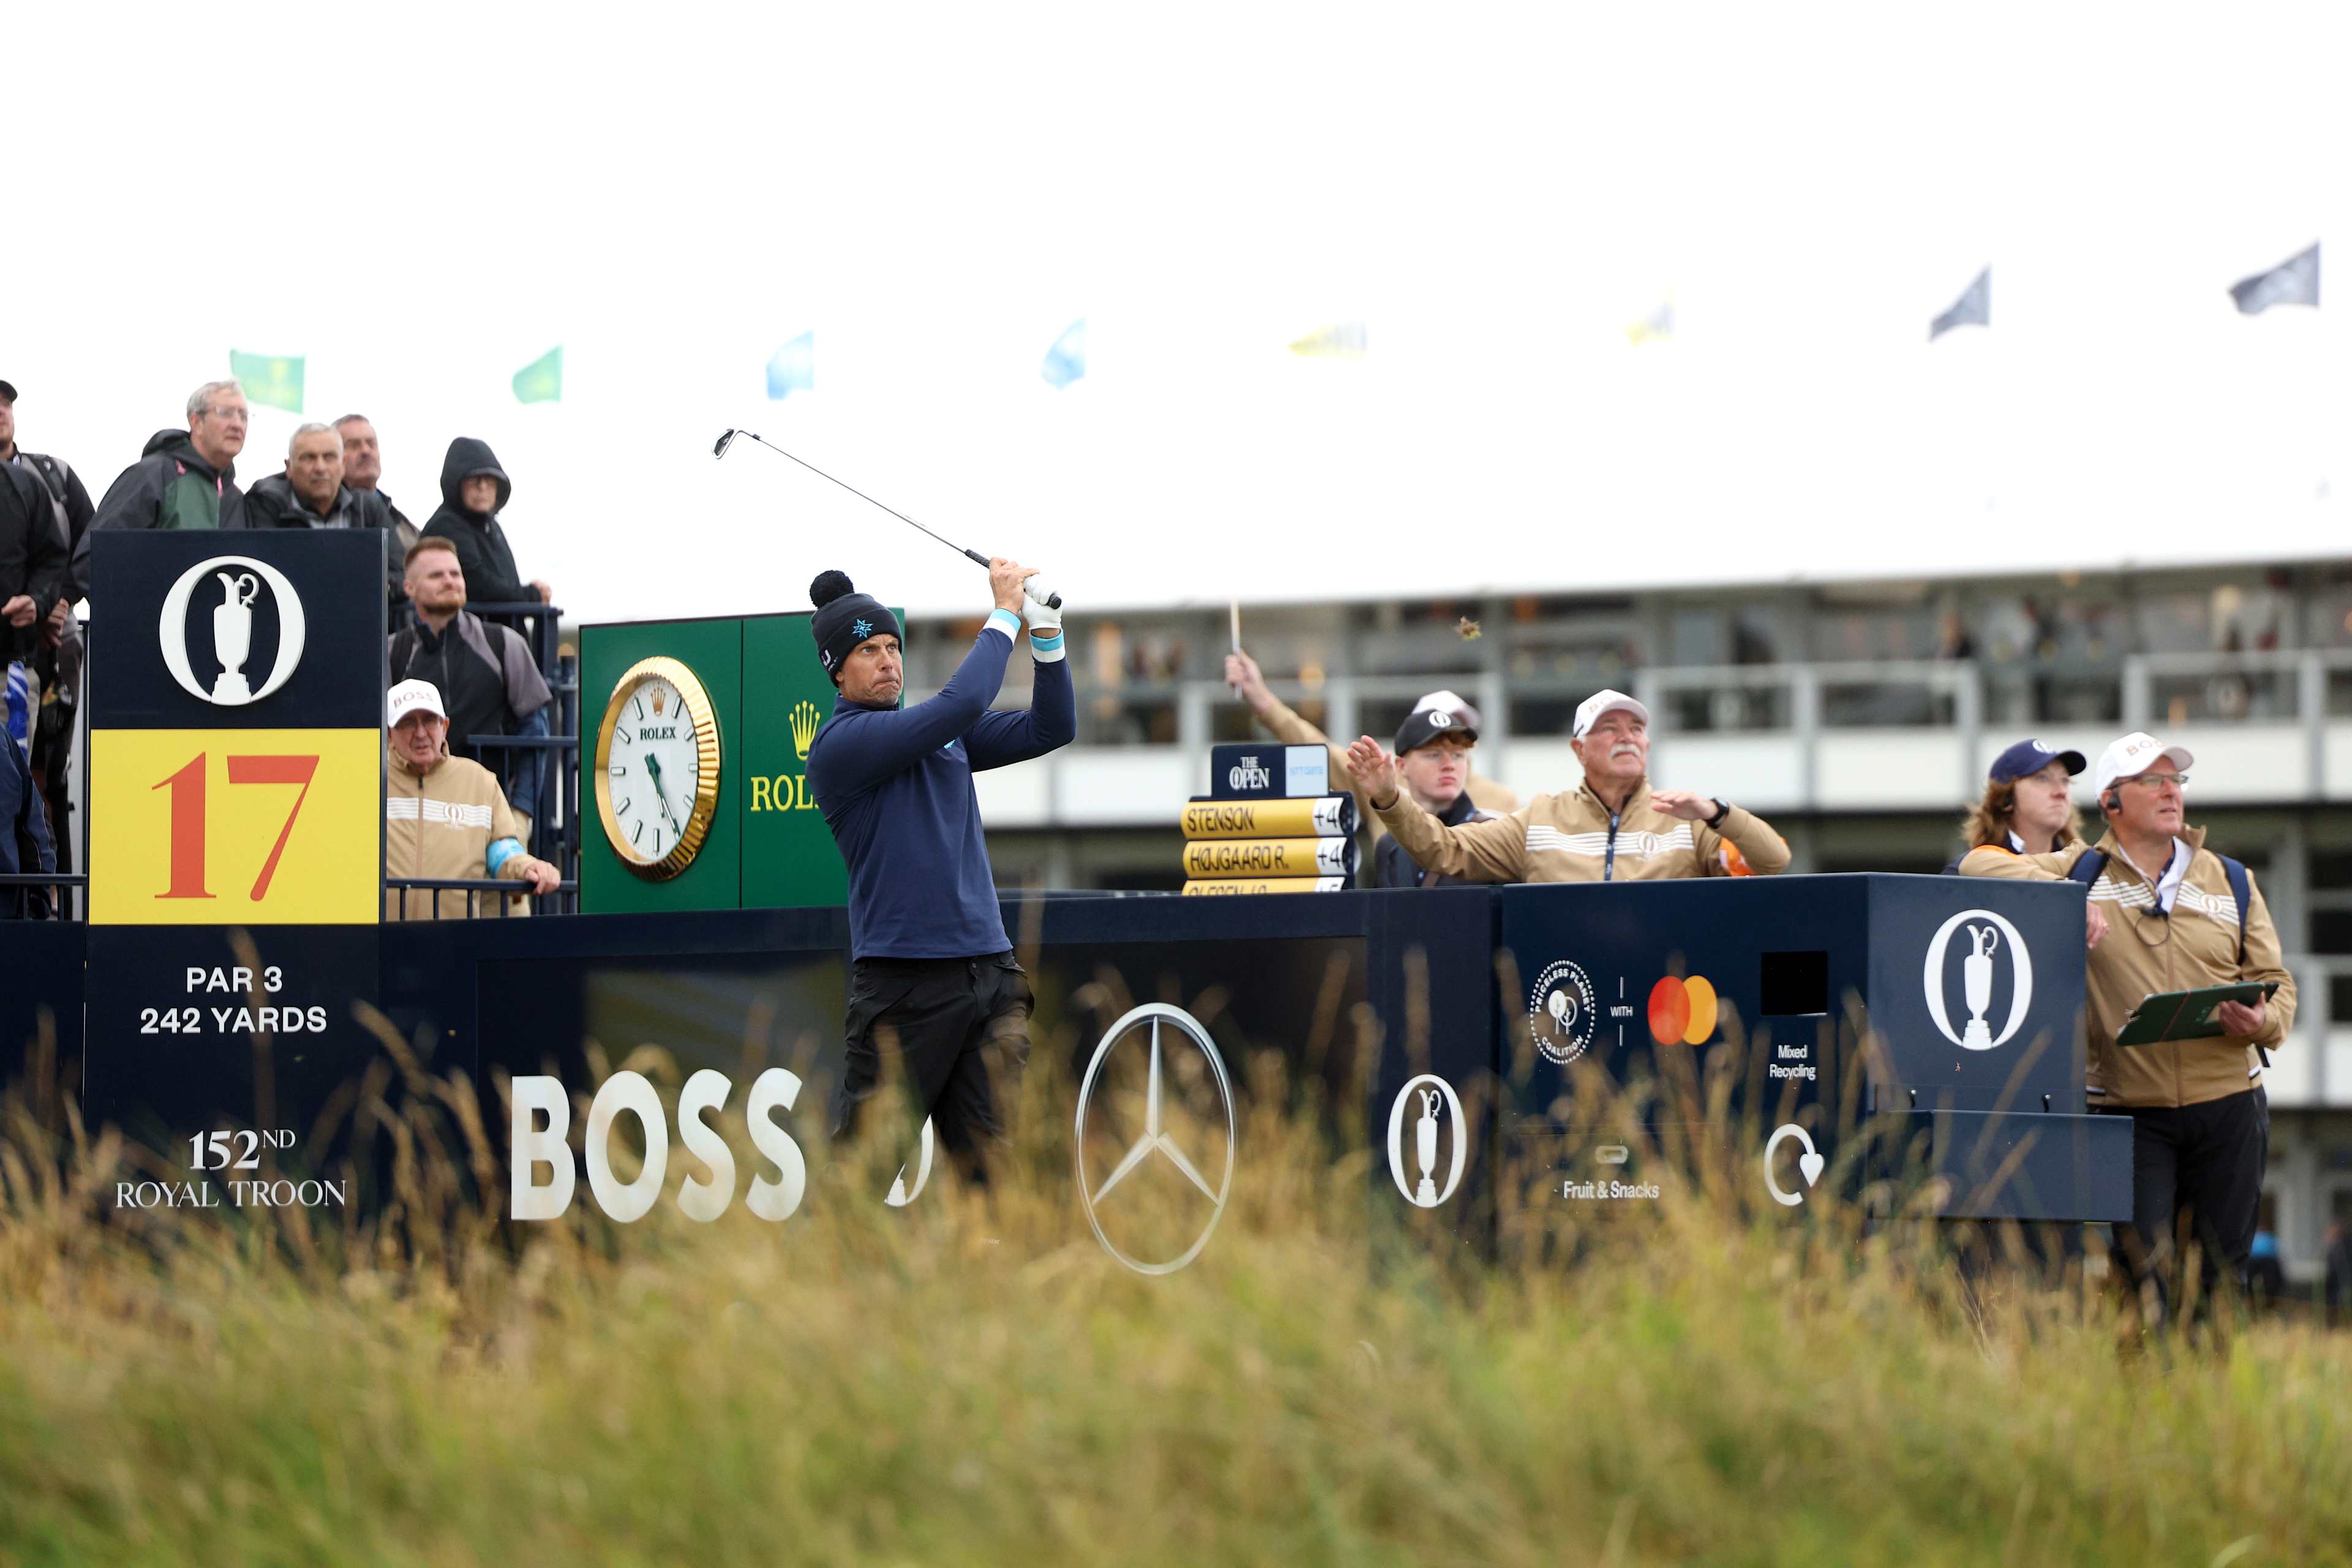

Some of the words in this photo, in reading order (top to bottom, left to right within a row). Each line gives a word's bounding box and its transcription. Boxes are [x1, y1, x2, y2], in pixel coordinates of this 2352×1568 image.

[639, 726, 676, 741] ROLEX
[1240, 756, 1259, 768] THE
[1229, 766, 1269, 790] OPEN
[750, 774, 820, 812] ROL
[151, 751, 320, 902] 17
[1187, 807, 1255, 832] STENSON
[1314, 805, 1337, 828] +4
[1317, 844, 1340, 868] +4
[186, 966, 254, 993] PAR
[263, 965, 283, 993] 3
[1535, 968, 1570, 1012] PRICELESS
[140, 1006, 202, 1035] 242
[210, 1005, 328, 1033] YARDS
[1610, 1005, 1634, 1017] WITH
[1542, 1035, 1583, 1057] COALITION
[1777, 1044, 1808, 1060] Mixed
[1769, 1063, 1817, 1081] Recycling
[510, 1067, 806, 1223] BOSS
[115, 1181, 220, 1208] ROYAL
[227, 1179, 347, 1208] TROON
[1563, 1180, 1596, 1199] Fruit
[1596, 1180, 1609, 1200] &
[1610, 1180, 1660, 1199] Snacks
